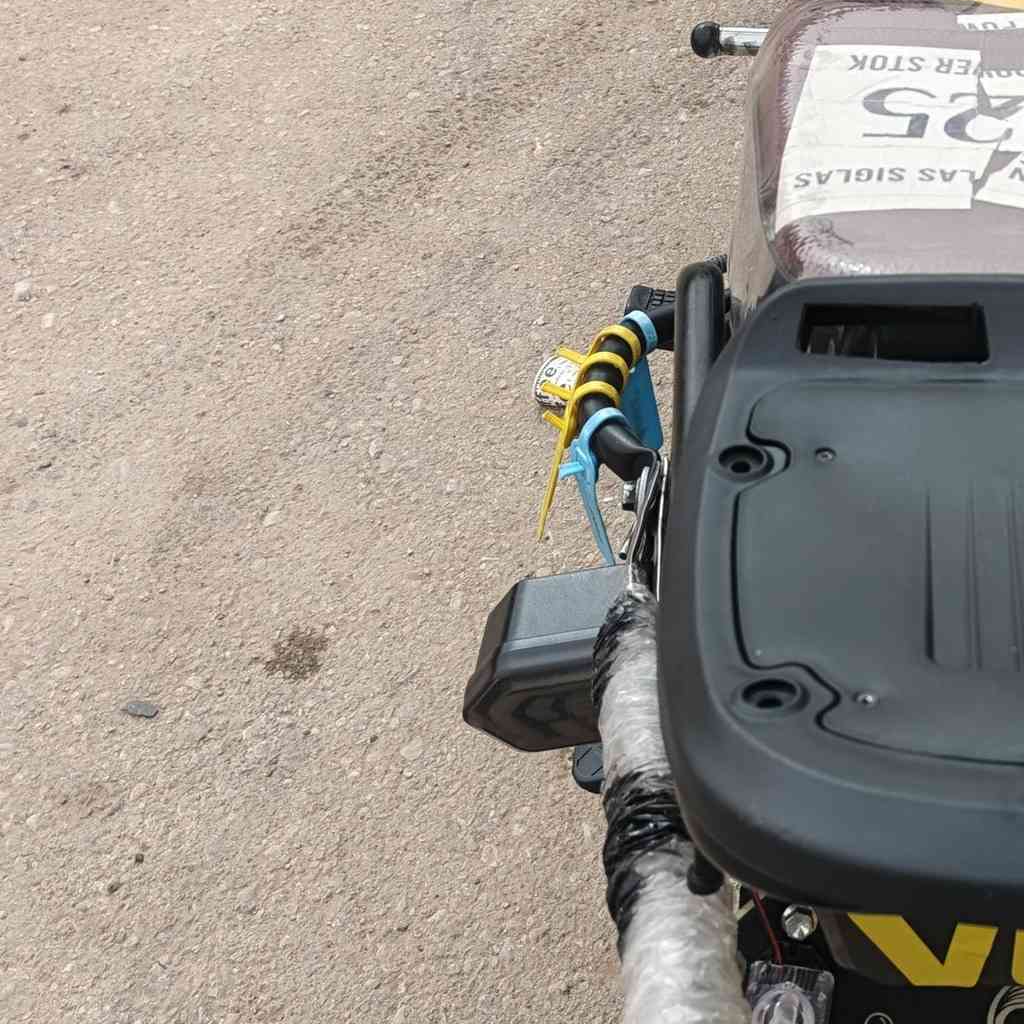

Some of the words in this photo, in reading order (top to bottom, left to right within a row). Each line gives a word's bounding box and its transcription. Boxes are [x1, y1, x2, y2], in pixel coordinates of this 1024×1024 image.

[849, 54, 926, 72] STOK
[794, 167, 905, 188] SIGLAS
[918, 167, 976, 184] LAS
